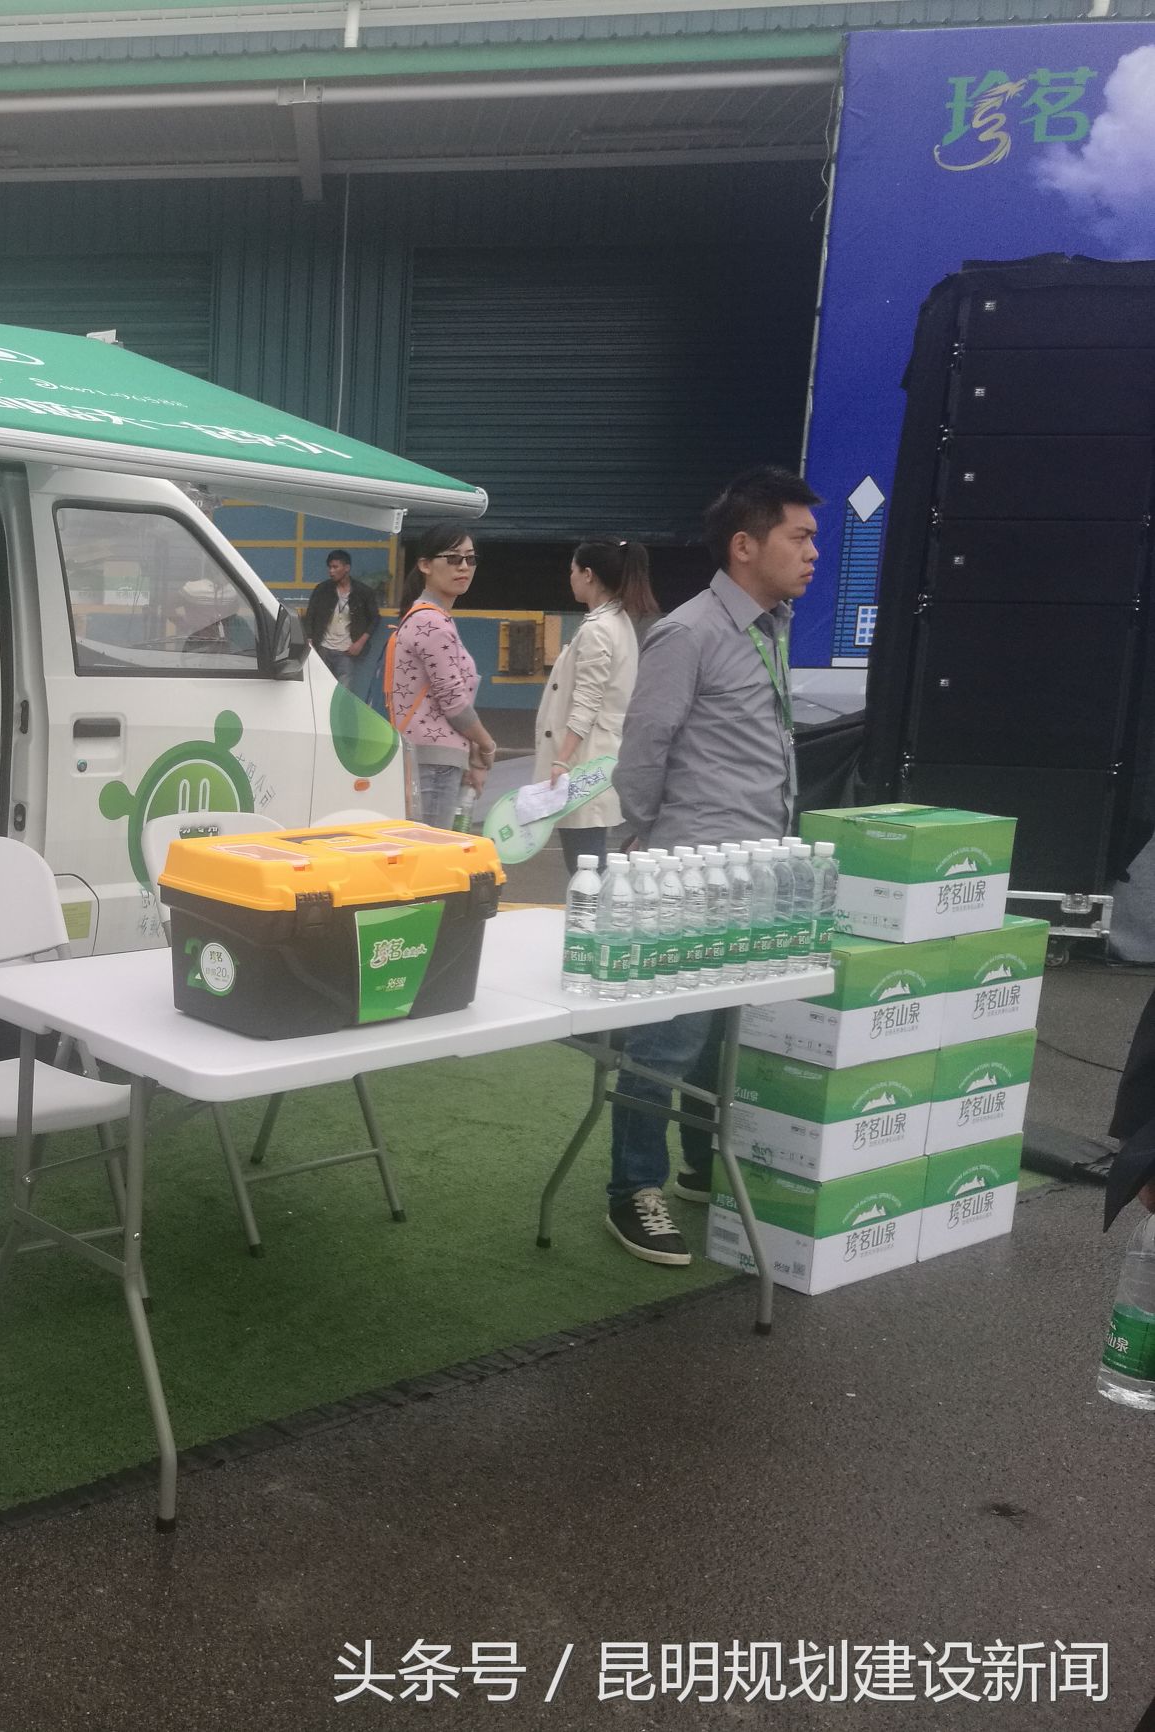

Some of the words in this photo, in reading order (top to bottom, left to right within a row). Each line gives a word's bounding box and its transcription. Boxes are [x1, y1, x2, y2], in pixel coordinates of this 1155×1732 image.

[934, 66, 1098, 171] 珍茗
[936, 880, 986, 914] 珍茗山泉
[870, 1002, 920, 1039] 珍茗山泉
[973, 985, 1021, 1019] 珍茗山泉
[957, 1091, 1005, 1127] 珍茗山泉
[853, 1112, 906, 1150] 珍茗山泉
[947, 1192, 994, 1229] 珍茗山泉
[845, 1222, 896, 1262] 珍茗山泉
